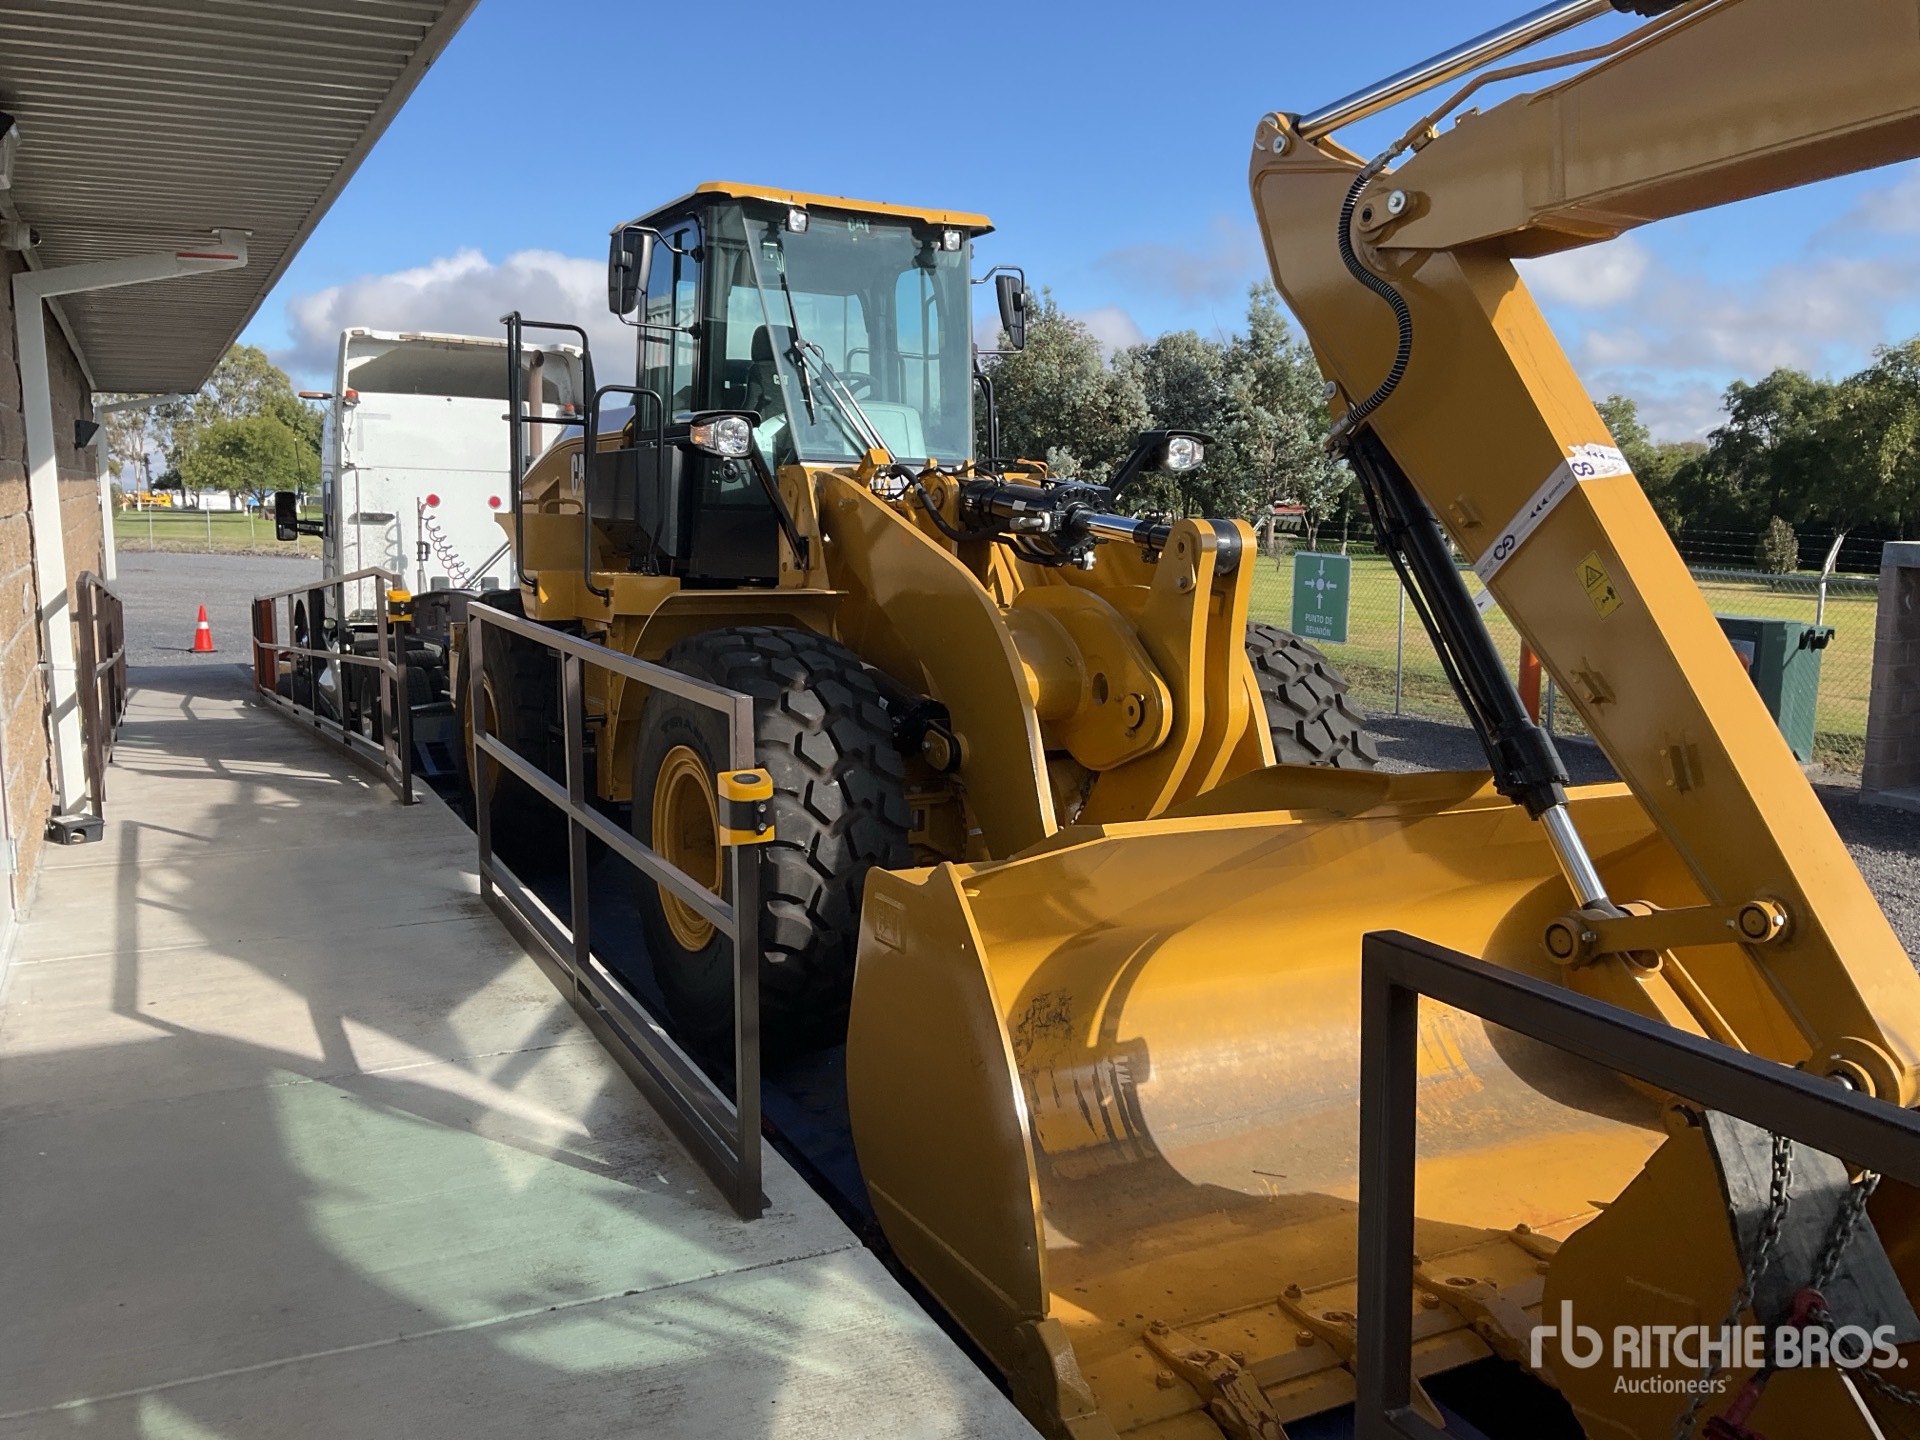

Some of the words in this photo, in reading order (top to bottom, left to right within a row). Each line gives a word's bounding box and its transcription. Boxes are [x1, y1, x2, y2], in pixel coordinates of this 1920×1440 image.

[1305, 613, 1324, 624] PUNTO
[1325, 616, 1333, 625] DE
[1305, 625, 1331, 636] REUNIÓN
